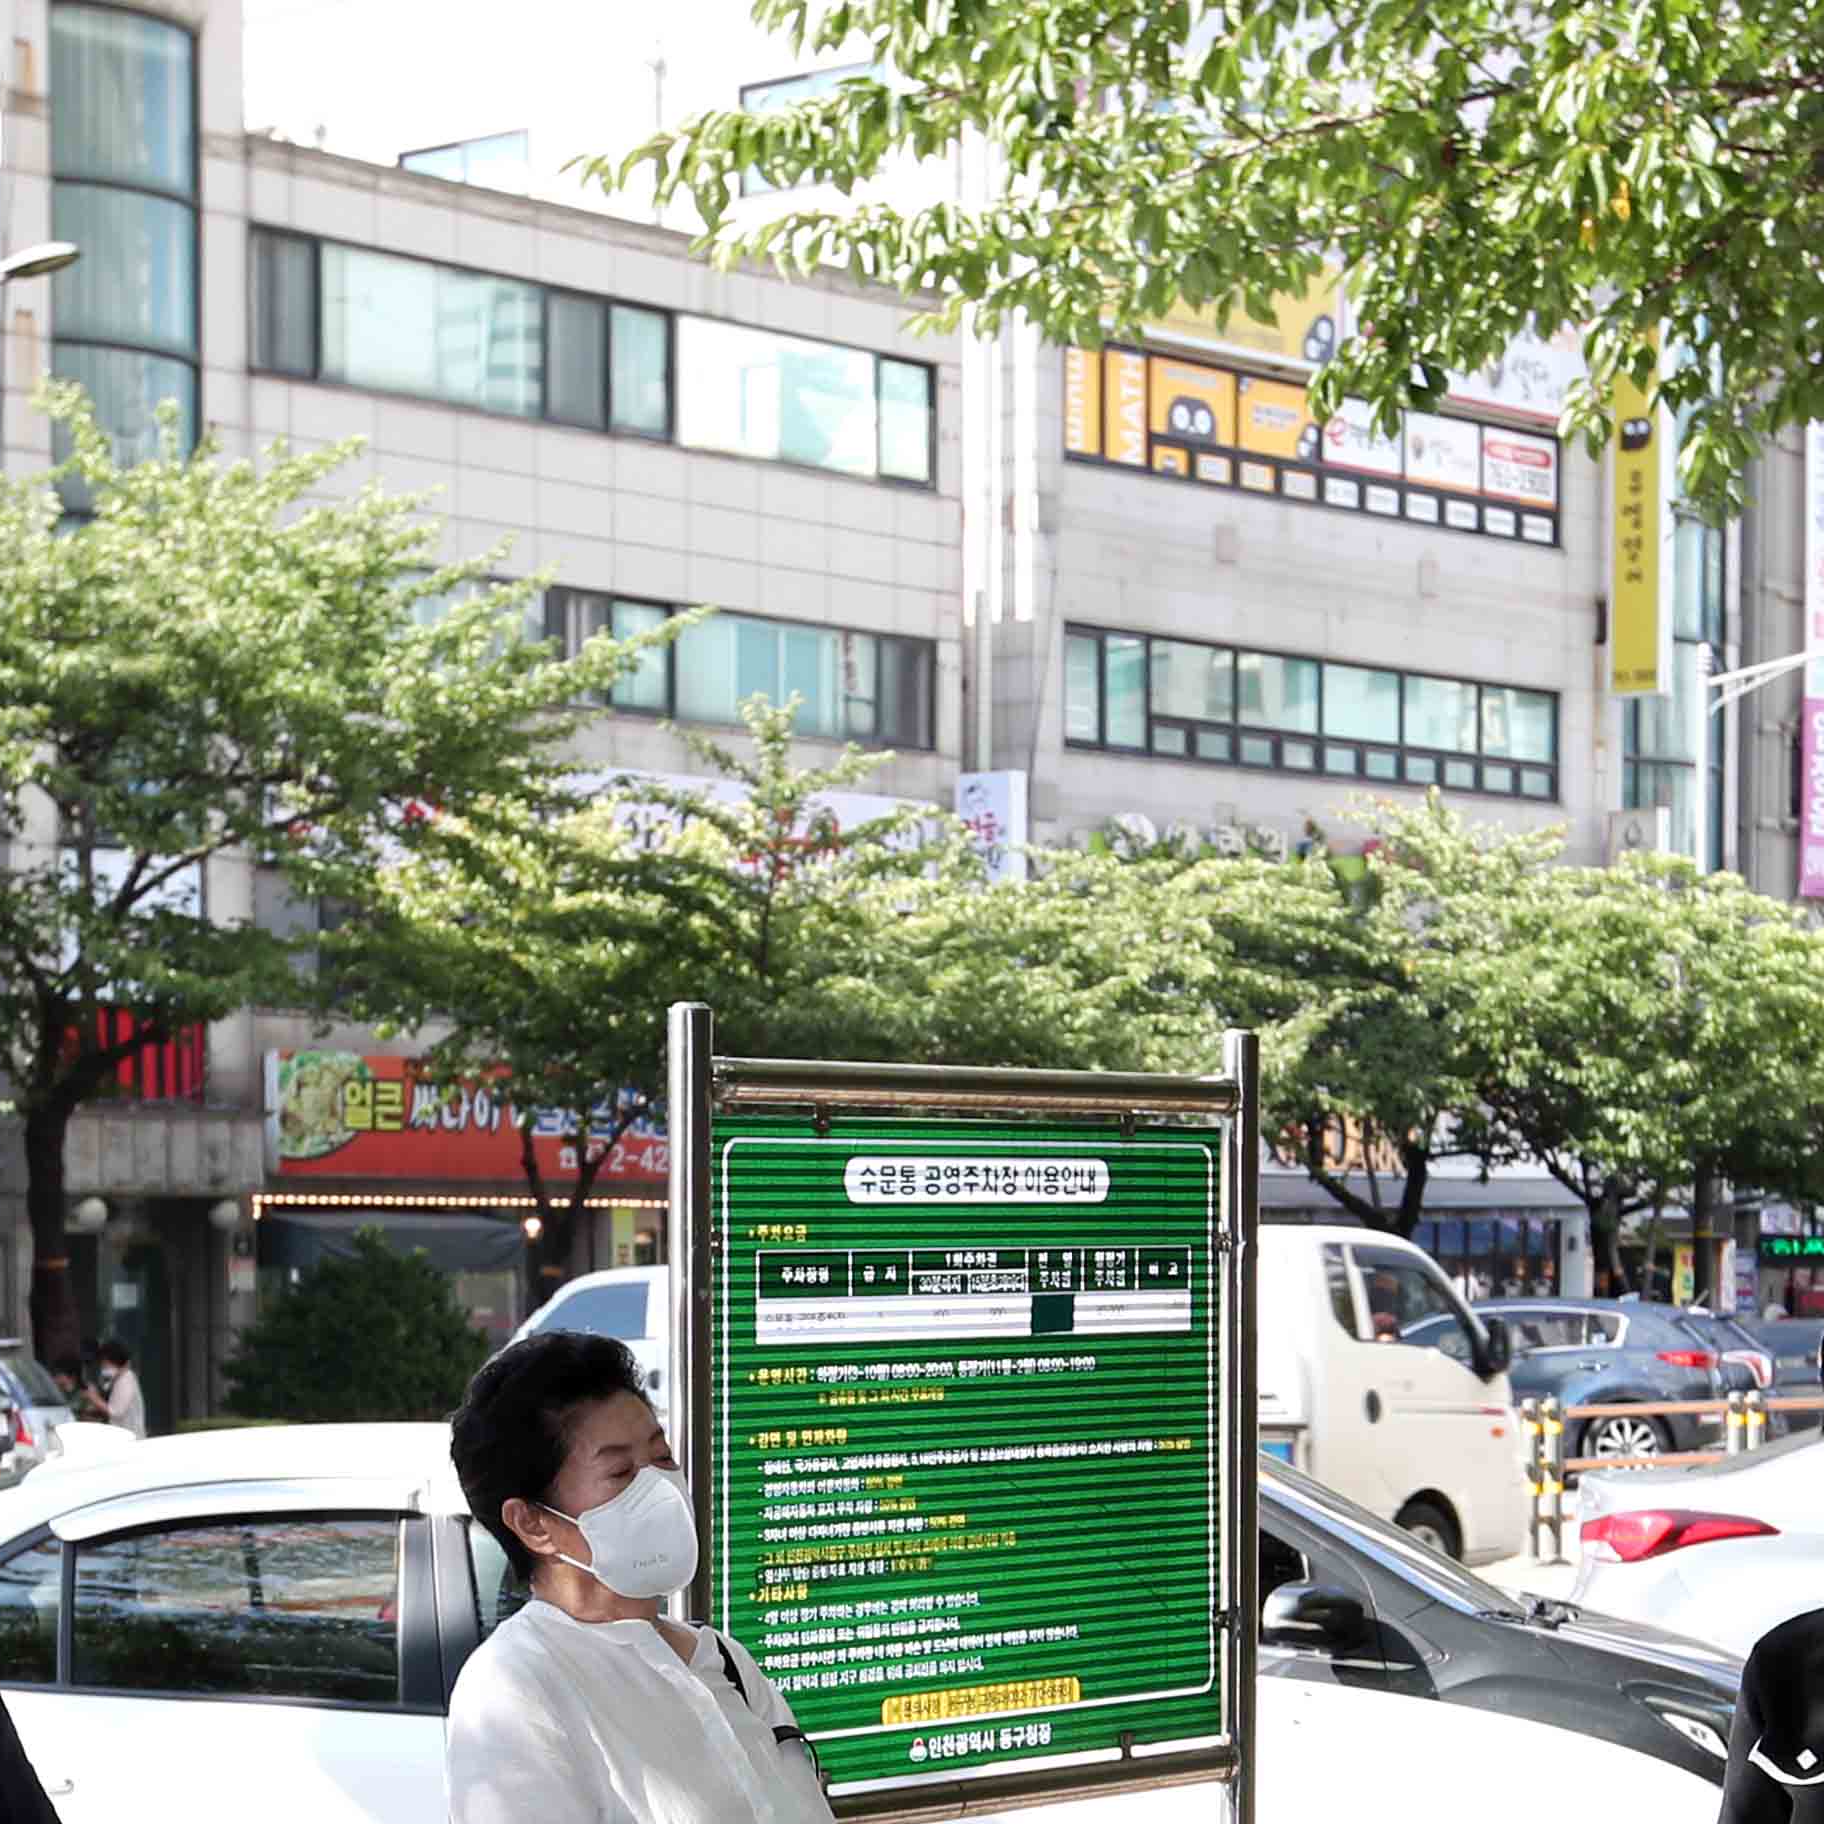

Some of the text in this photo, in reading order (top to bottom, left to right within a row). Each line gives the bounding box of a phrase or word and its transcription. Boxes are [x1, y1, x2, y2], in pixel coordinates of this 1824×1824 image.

[343, 1080, 404, 1132] 얼큰
[860, 1166, 1096, 1195] 수문통 공영주차장 이용안내
[758, 1584, 808, 1602] 기타사항
[929, 1722, 1052, 1759] 인천광역시 동구청장
